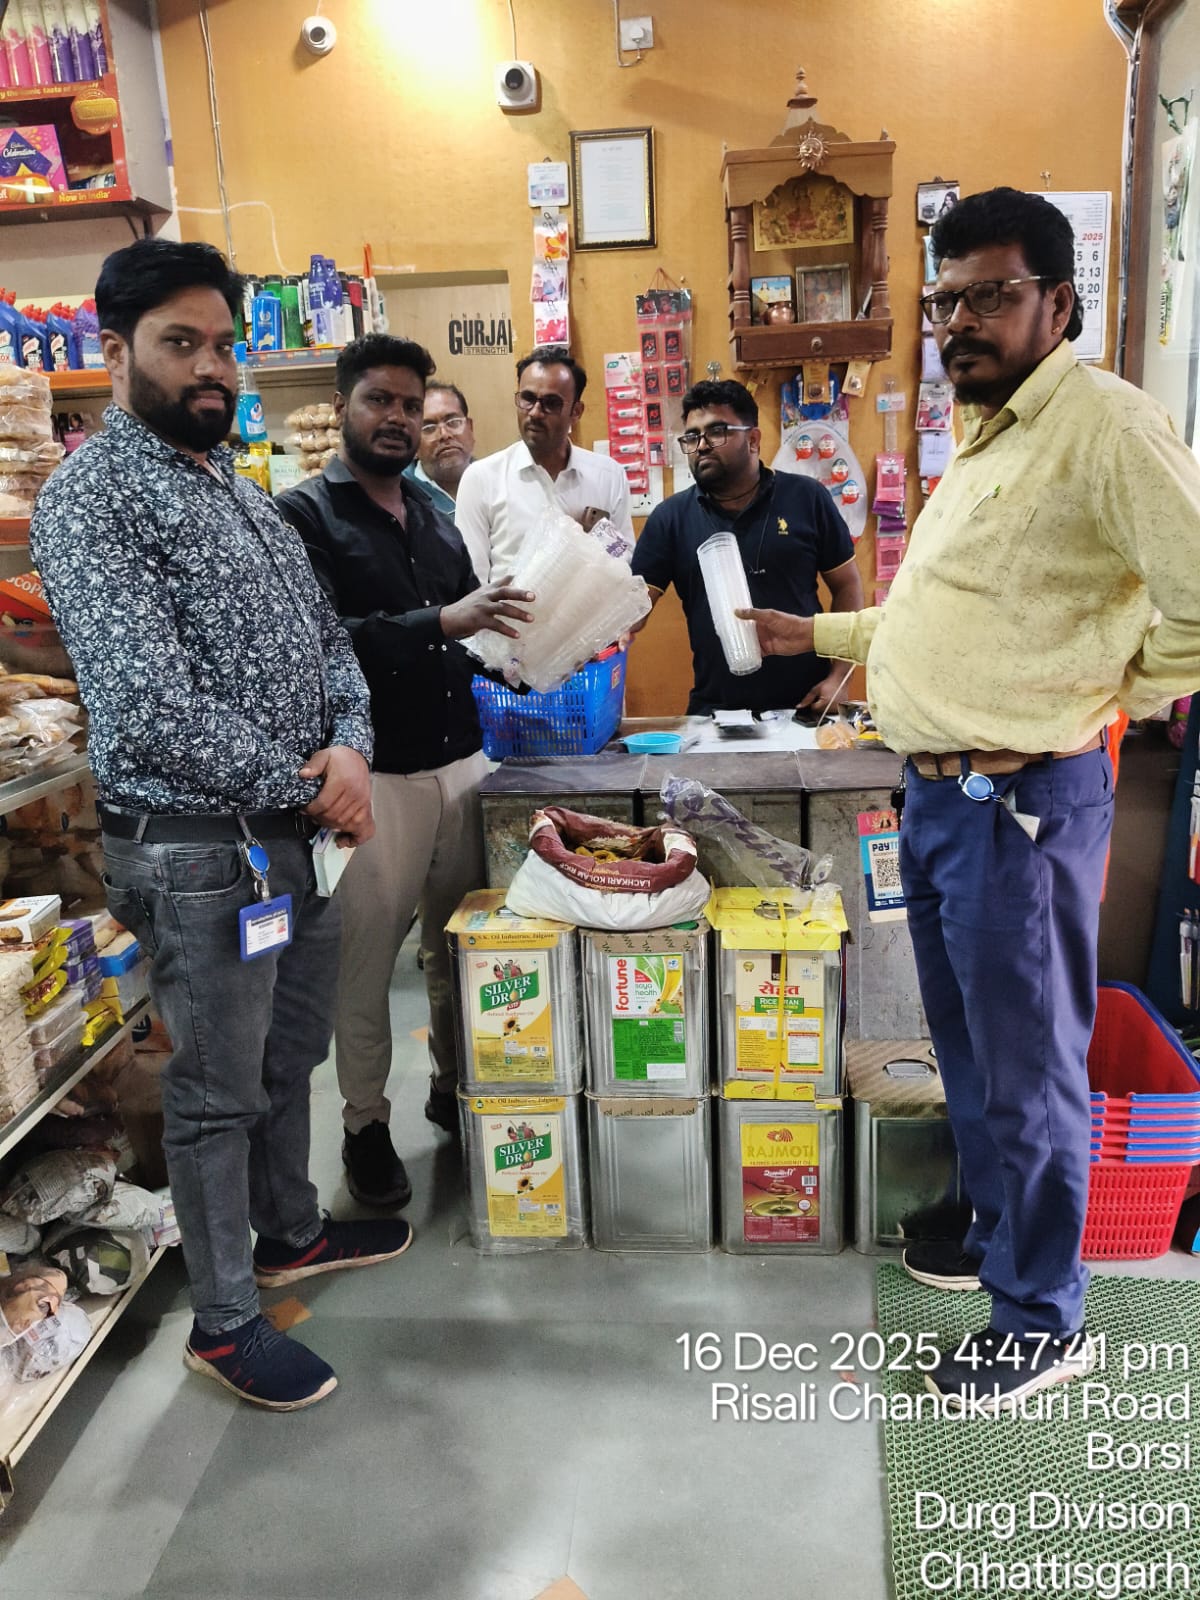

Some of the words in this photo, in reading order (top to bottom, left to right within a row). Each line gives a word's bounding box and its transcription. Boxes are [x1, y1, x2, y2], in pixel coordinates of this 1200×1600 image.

[43, 86, 62, 94] taste
[1082, 233, 1104, 241] 2025
[1076, 251, 1083, 261] 5
[1092, 251, 1099, 261] 6
[1089, 267, 1101, 278] 13
[1087, 283, 1100, 294] 20
[1086, 299, 1099, 310] 27
[577, 871, 606, 884] KOLAM
[607, 876, 651, 888] LACHKARI
[485, 976, 531, 997] SILVER
[616, 958, 630, 1011] fortune
[500, 1137, 544, 1157] SILVER
[747, 1145, 814, 1158] RAJMOTI
